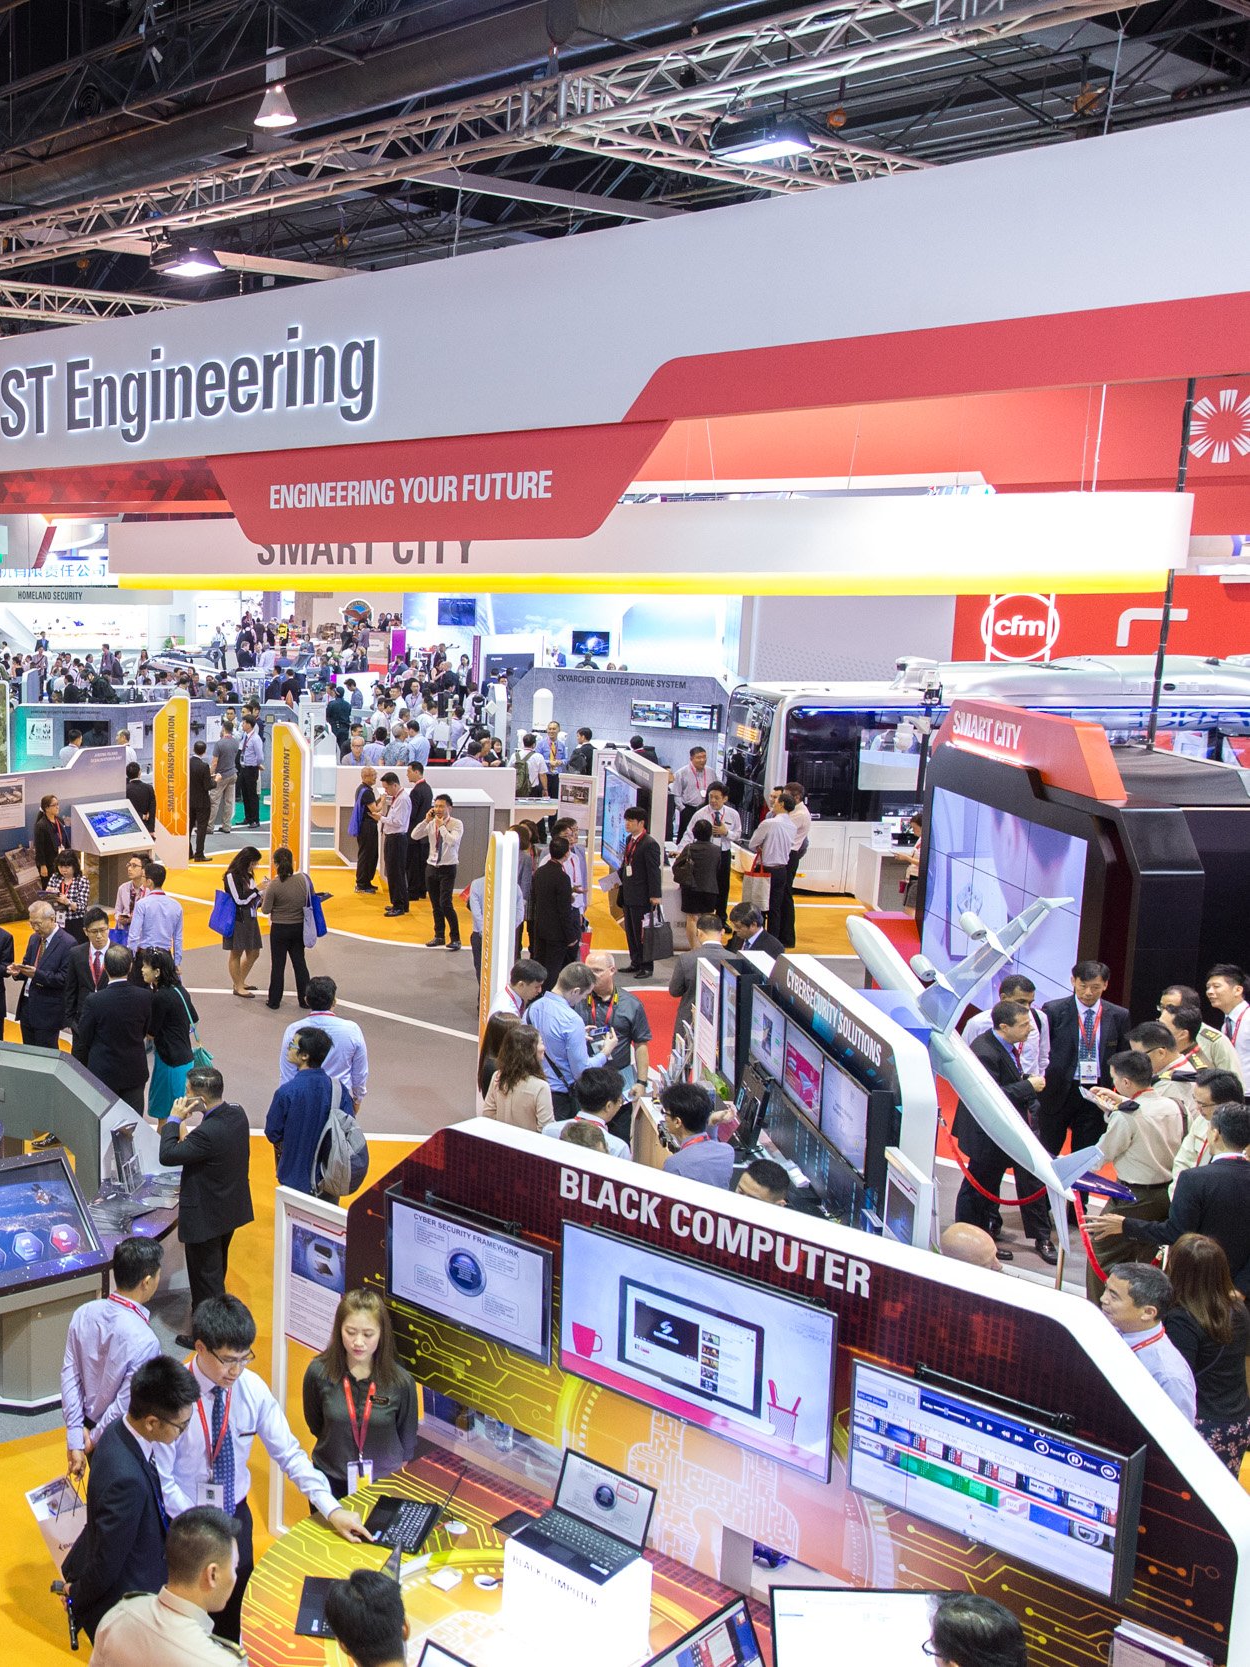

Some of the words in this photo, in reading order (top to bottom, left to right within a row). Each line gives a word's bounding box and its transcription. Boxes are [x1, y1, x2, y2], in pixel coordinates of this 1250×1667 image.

[0, 364, 54, 439] ST
[65, 326, 378, 444] Engineering
[269, 479, 395, 510] ENGINEERING
[398, 473, 458, 505] YOUR
[461, 470, 553, 502] FUTURE
[17, 590, 52, 601] HOMELAND
[53, 590, 83, 601] SECURITY
[995, 615, 1046, 637] cfm
[557, 674, 596, 684] SKYARCHER
[596, 676, 630, 686] COUNTER
[630, 678, 655, 688] DRONE
[656, 679, 687, 689] SYSTEM
[167, 714, 175, 783] TRANSPORTATION
[952, 710, 992, 744] SMART
[993, 719, 1022, 751] CITY
[167, 783, 175, 813] SMART
[282, 747, 290, 817] ENVIRONMENT
[281, 818, 290, 849] SMART
[786, 968, 838, 1028] CYBERSECURITY
[838, 1012, 882, 1067] SOLUTIONS
[413, 1213, 437, 1226] CYBER
[437, 1220, 472, 1240] SECURITY
[472, 1233, 519, 1258] FRAMEWORK
[559, 1164, 662, 1228] BLACK
[669, 1199, 873, 1298] COMPUTER
